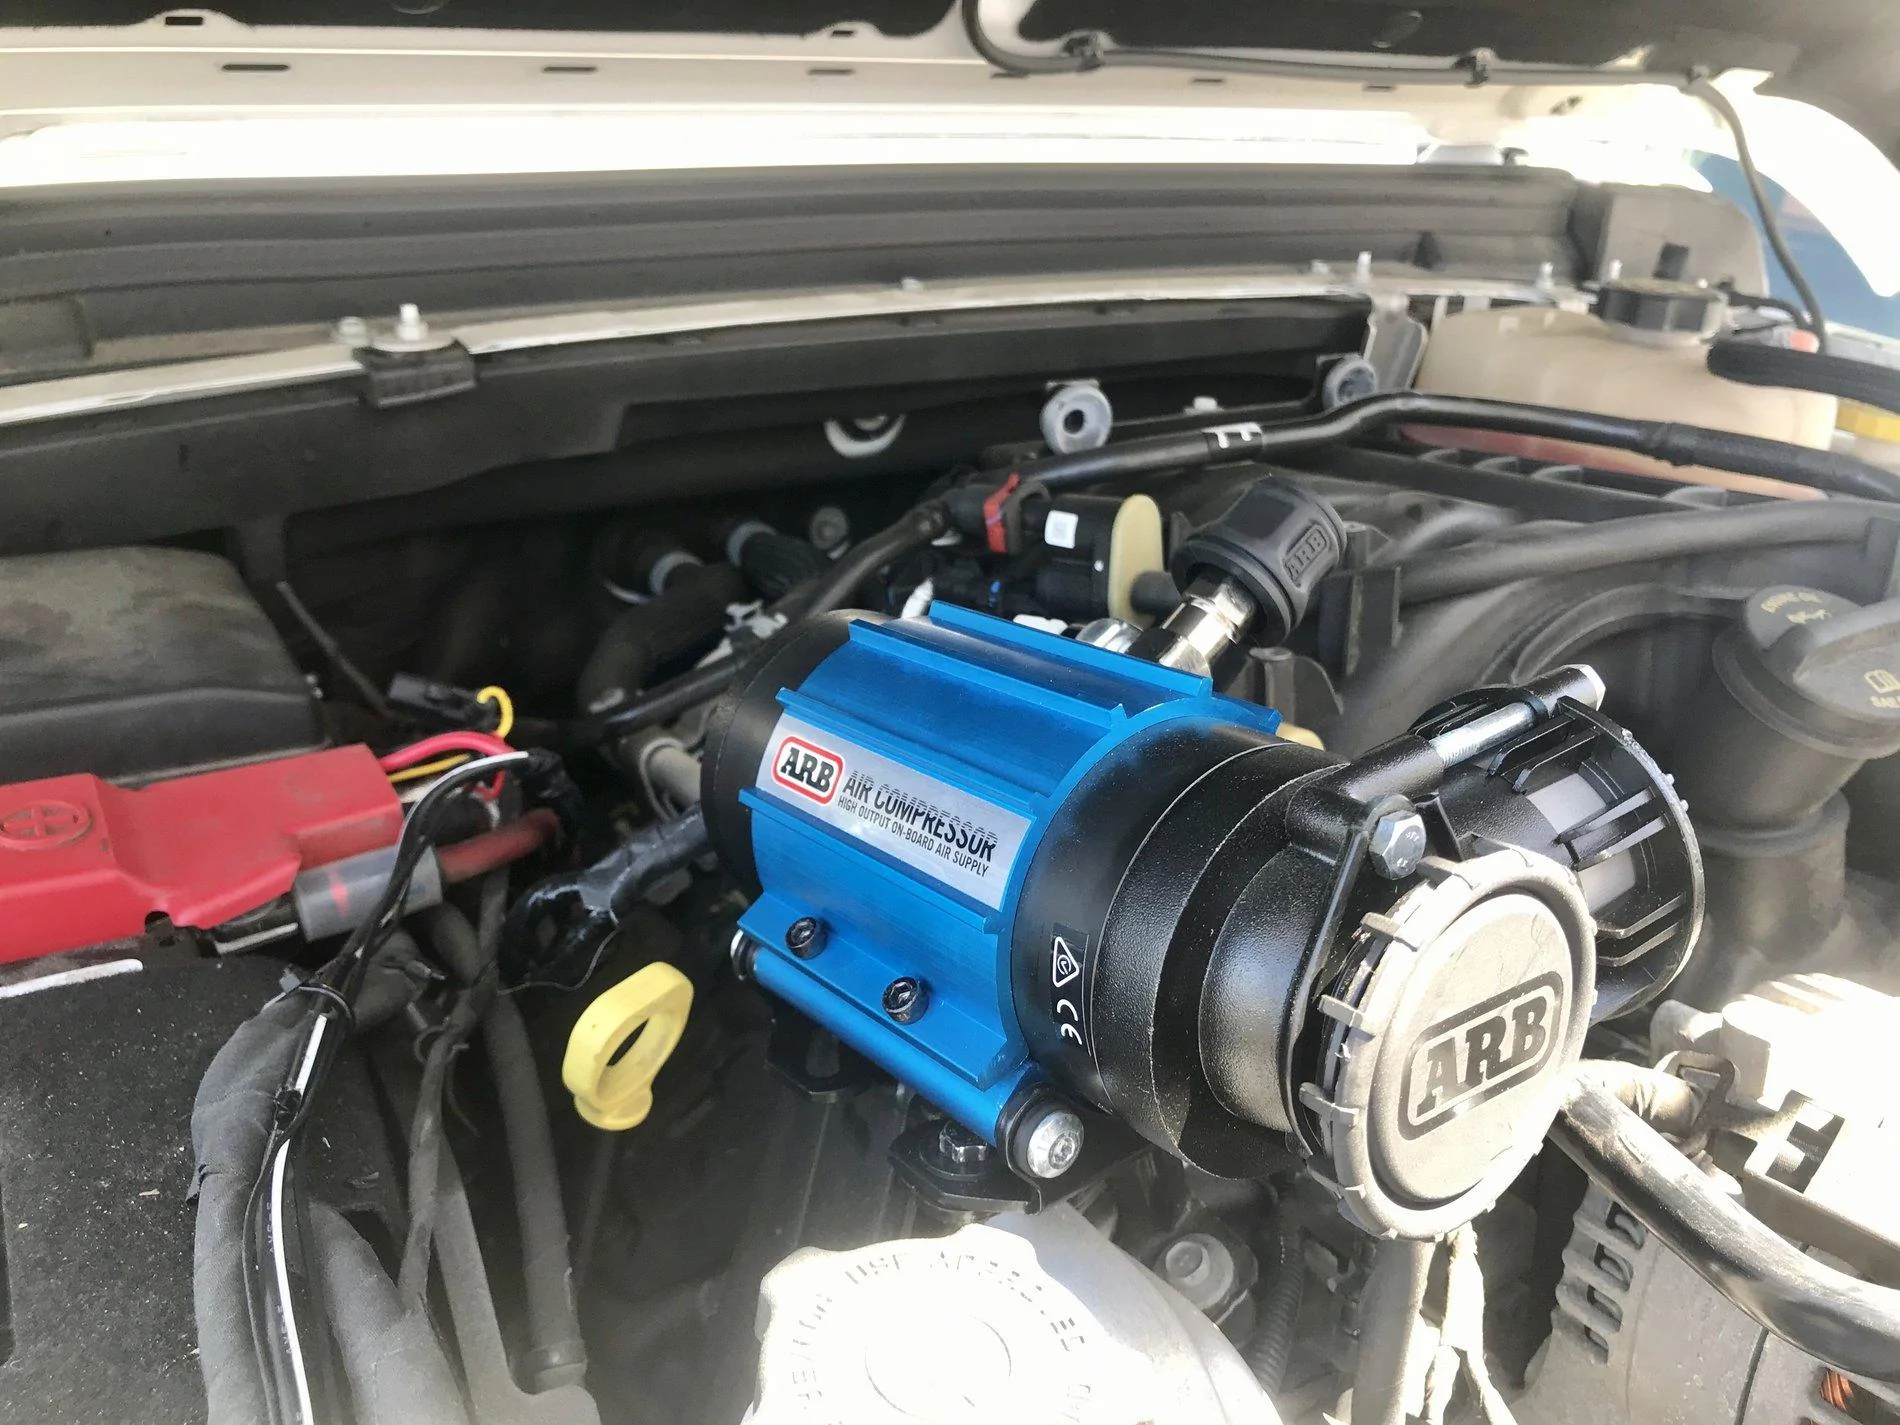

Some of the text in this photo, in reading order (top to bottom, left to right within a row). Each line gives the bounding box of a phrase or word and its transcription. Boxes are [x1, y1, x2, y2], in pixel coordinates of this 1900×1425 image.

[1284, 528, 1326, 581] ARB
[780, 747, 834, 793] ARB
[837, 796, 989, 877] HIGH OUTPUT ON-BOARD AIR SUPPLY
[842, 770, 998, 862] AIR COMPRESSOR
[1416, 996, 1547, 1118] ARB
